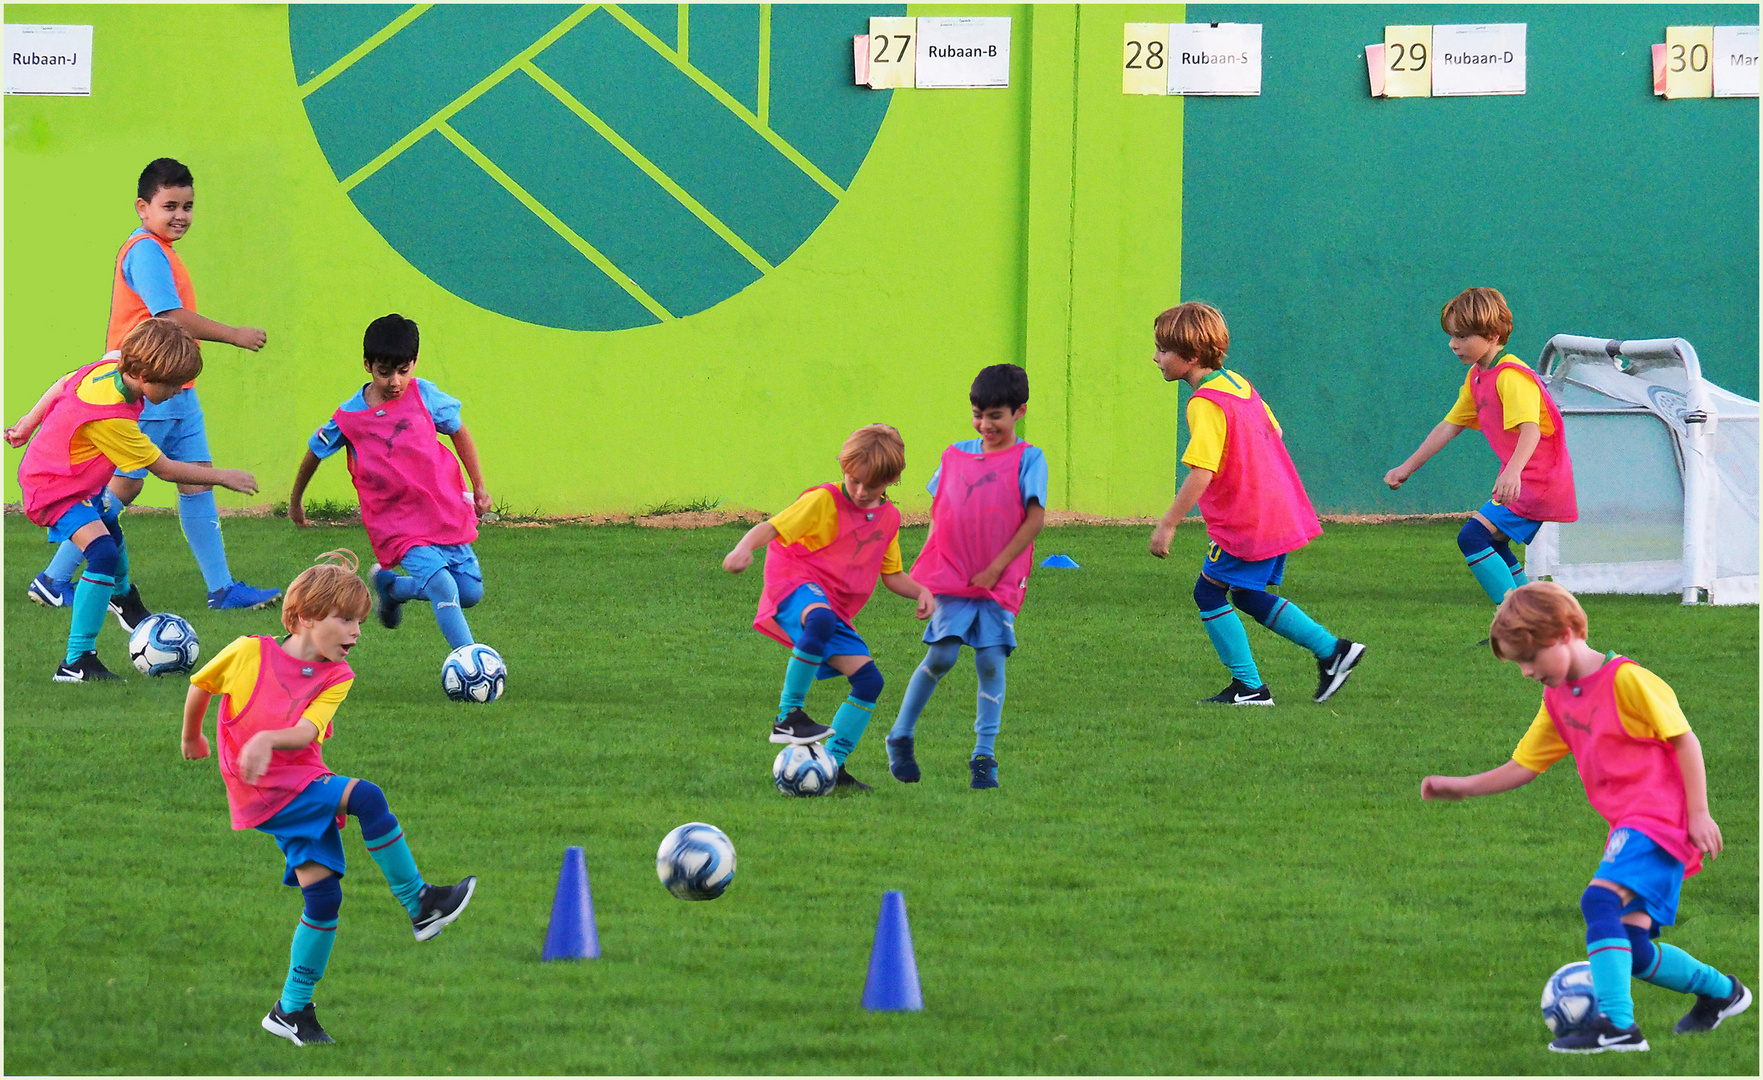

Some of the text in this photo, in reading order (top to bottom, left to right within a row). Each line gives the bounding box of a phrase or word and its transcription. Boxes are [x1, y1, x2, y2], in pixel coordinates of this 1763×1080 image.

[873, 34, 911, 63] 27
[929, 45, 997, 58] Rubaan-B
[1125, 40, 1164, 70] 28
[12, 52, 77, 65] Rubaan-J
[1182, 51, 1249, 65] Rubaan-S
[1390, 43, 1427, 72] 29
[1444, 51, 1514, 65] Rubaan-D
[1670, 43, 1709, 72] 30
[1730, 54, 1759, 66] Mar
